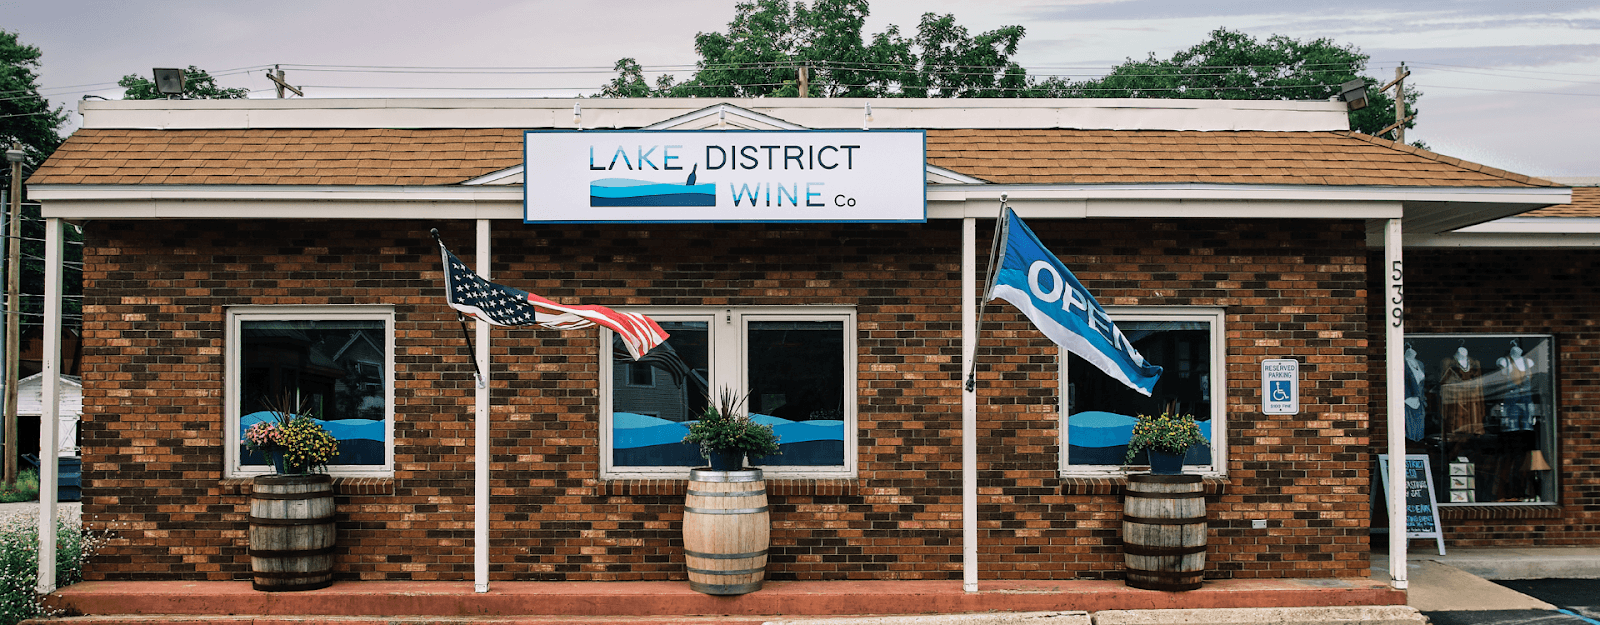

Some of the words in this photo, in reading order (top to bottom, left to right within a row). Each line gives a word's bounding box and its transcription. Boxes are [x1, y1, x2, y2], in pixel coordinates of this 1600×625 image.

[590, 145, 683, 170] LAKE
[706, 145, 861, 170] DISTRICT
[730, 182, 826, 207] WINE
[834, 194, 857, 207] Co
[1028, 260, 1144, 368] OPEN
[1392, 261, 1404, 328] 539
